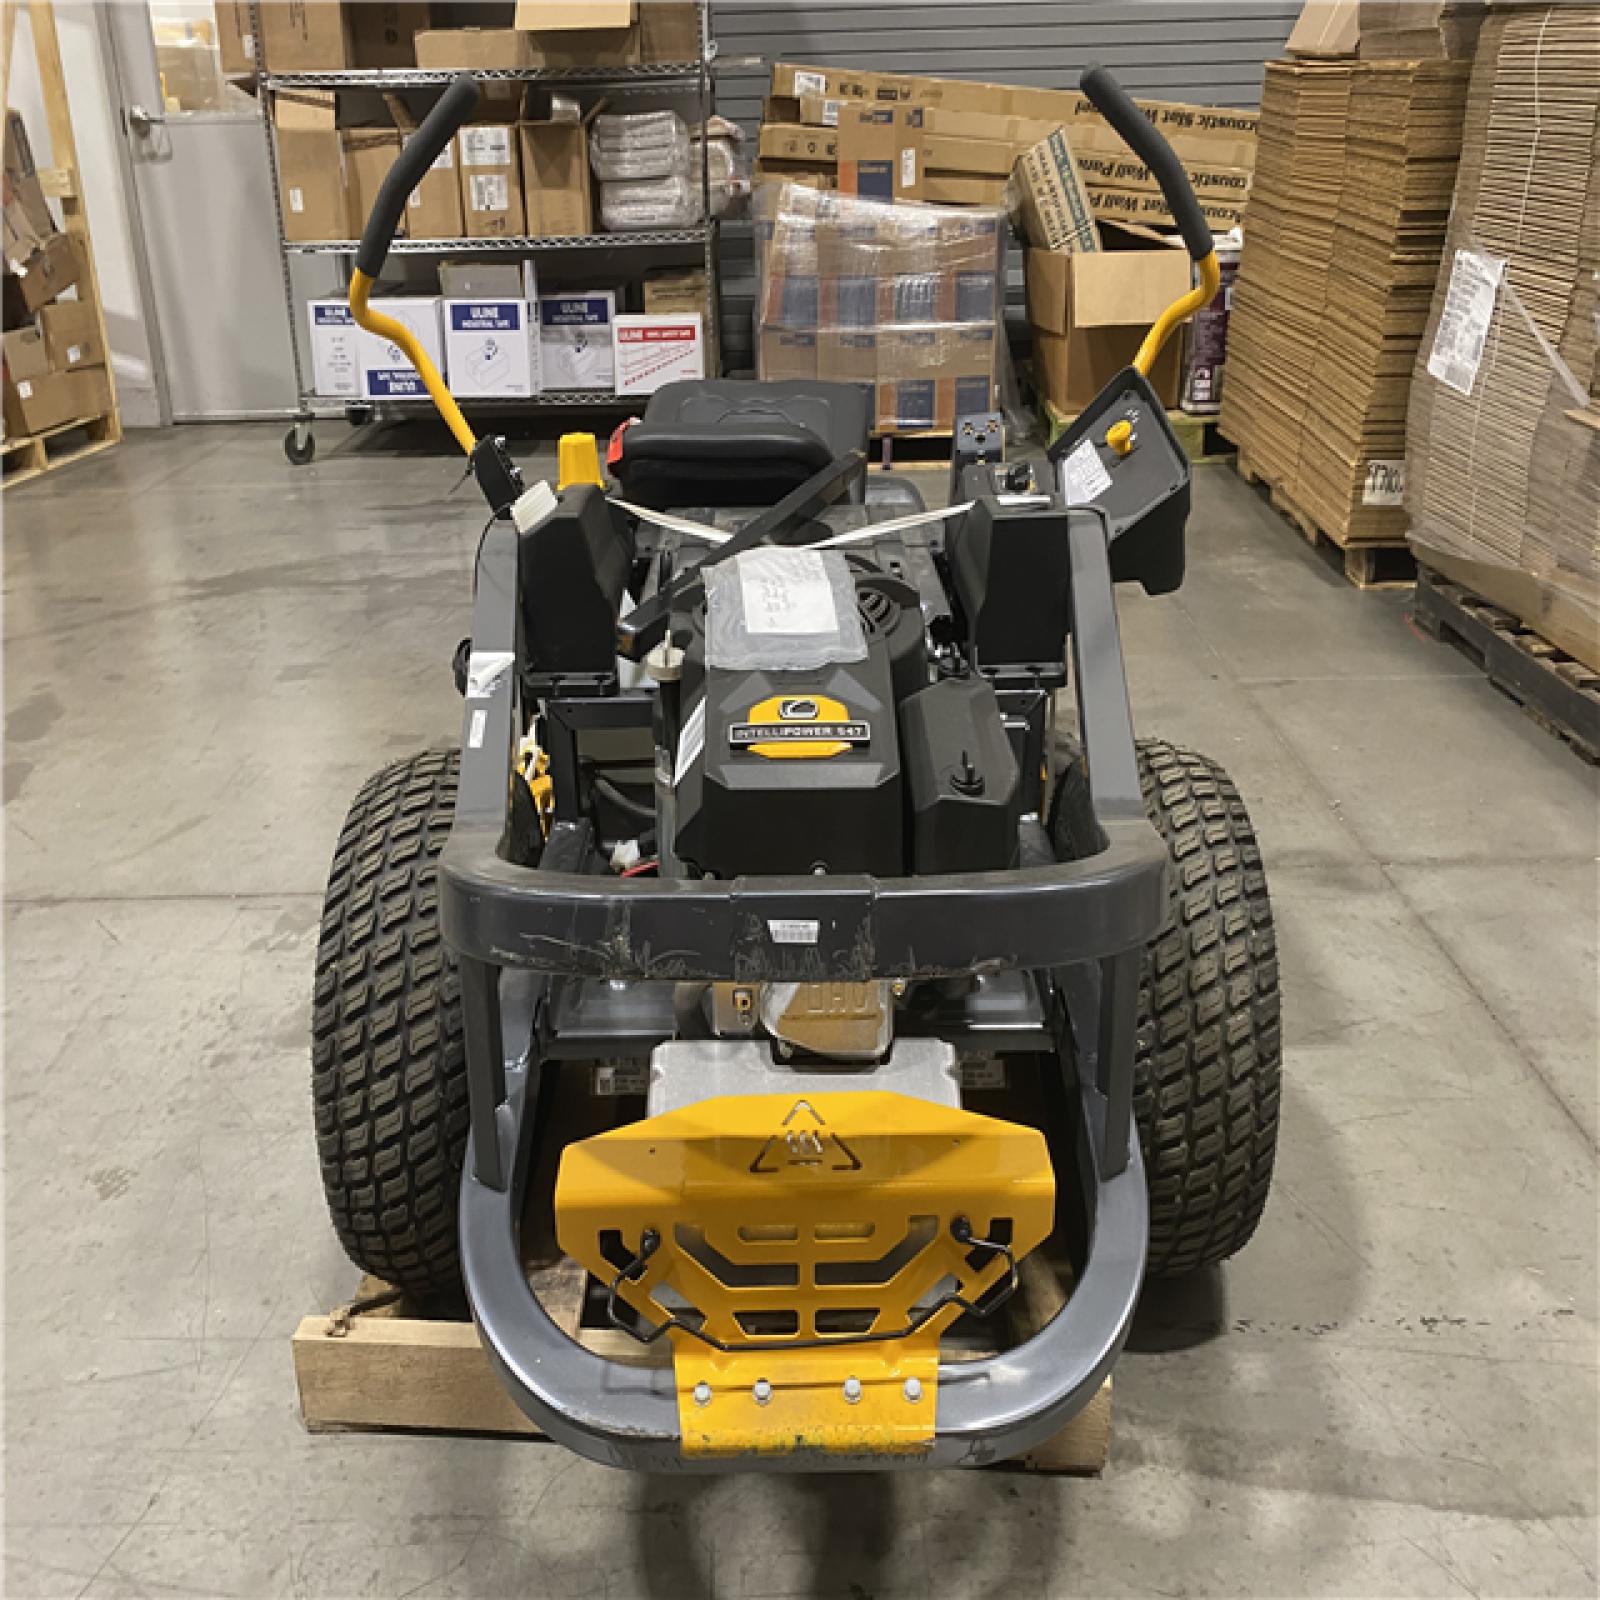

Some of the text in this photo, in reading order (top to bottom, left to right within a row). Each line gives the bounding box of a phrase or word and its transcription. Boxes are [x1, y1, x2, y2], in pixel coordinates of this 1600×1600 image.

[1163, 111, 1194, 129] Slat
[470, 307, 498, 318] ULINE
[734, 727, 862, 739] INTELLIPOWER 547
